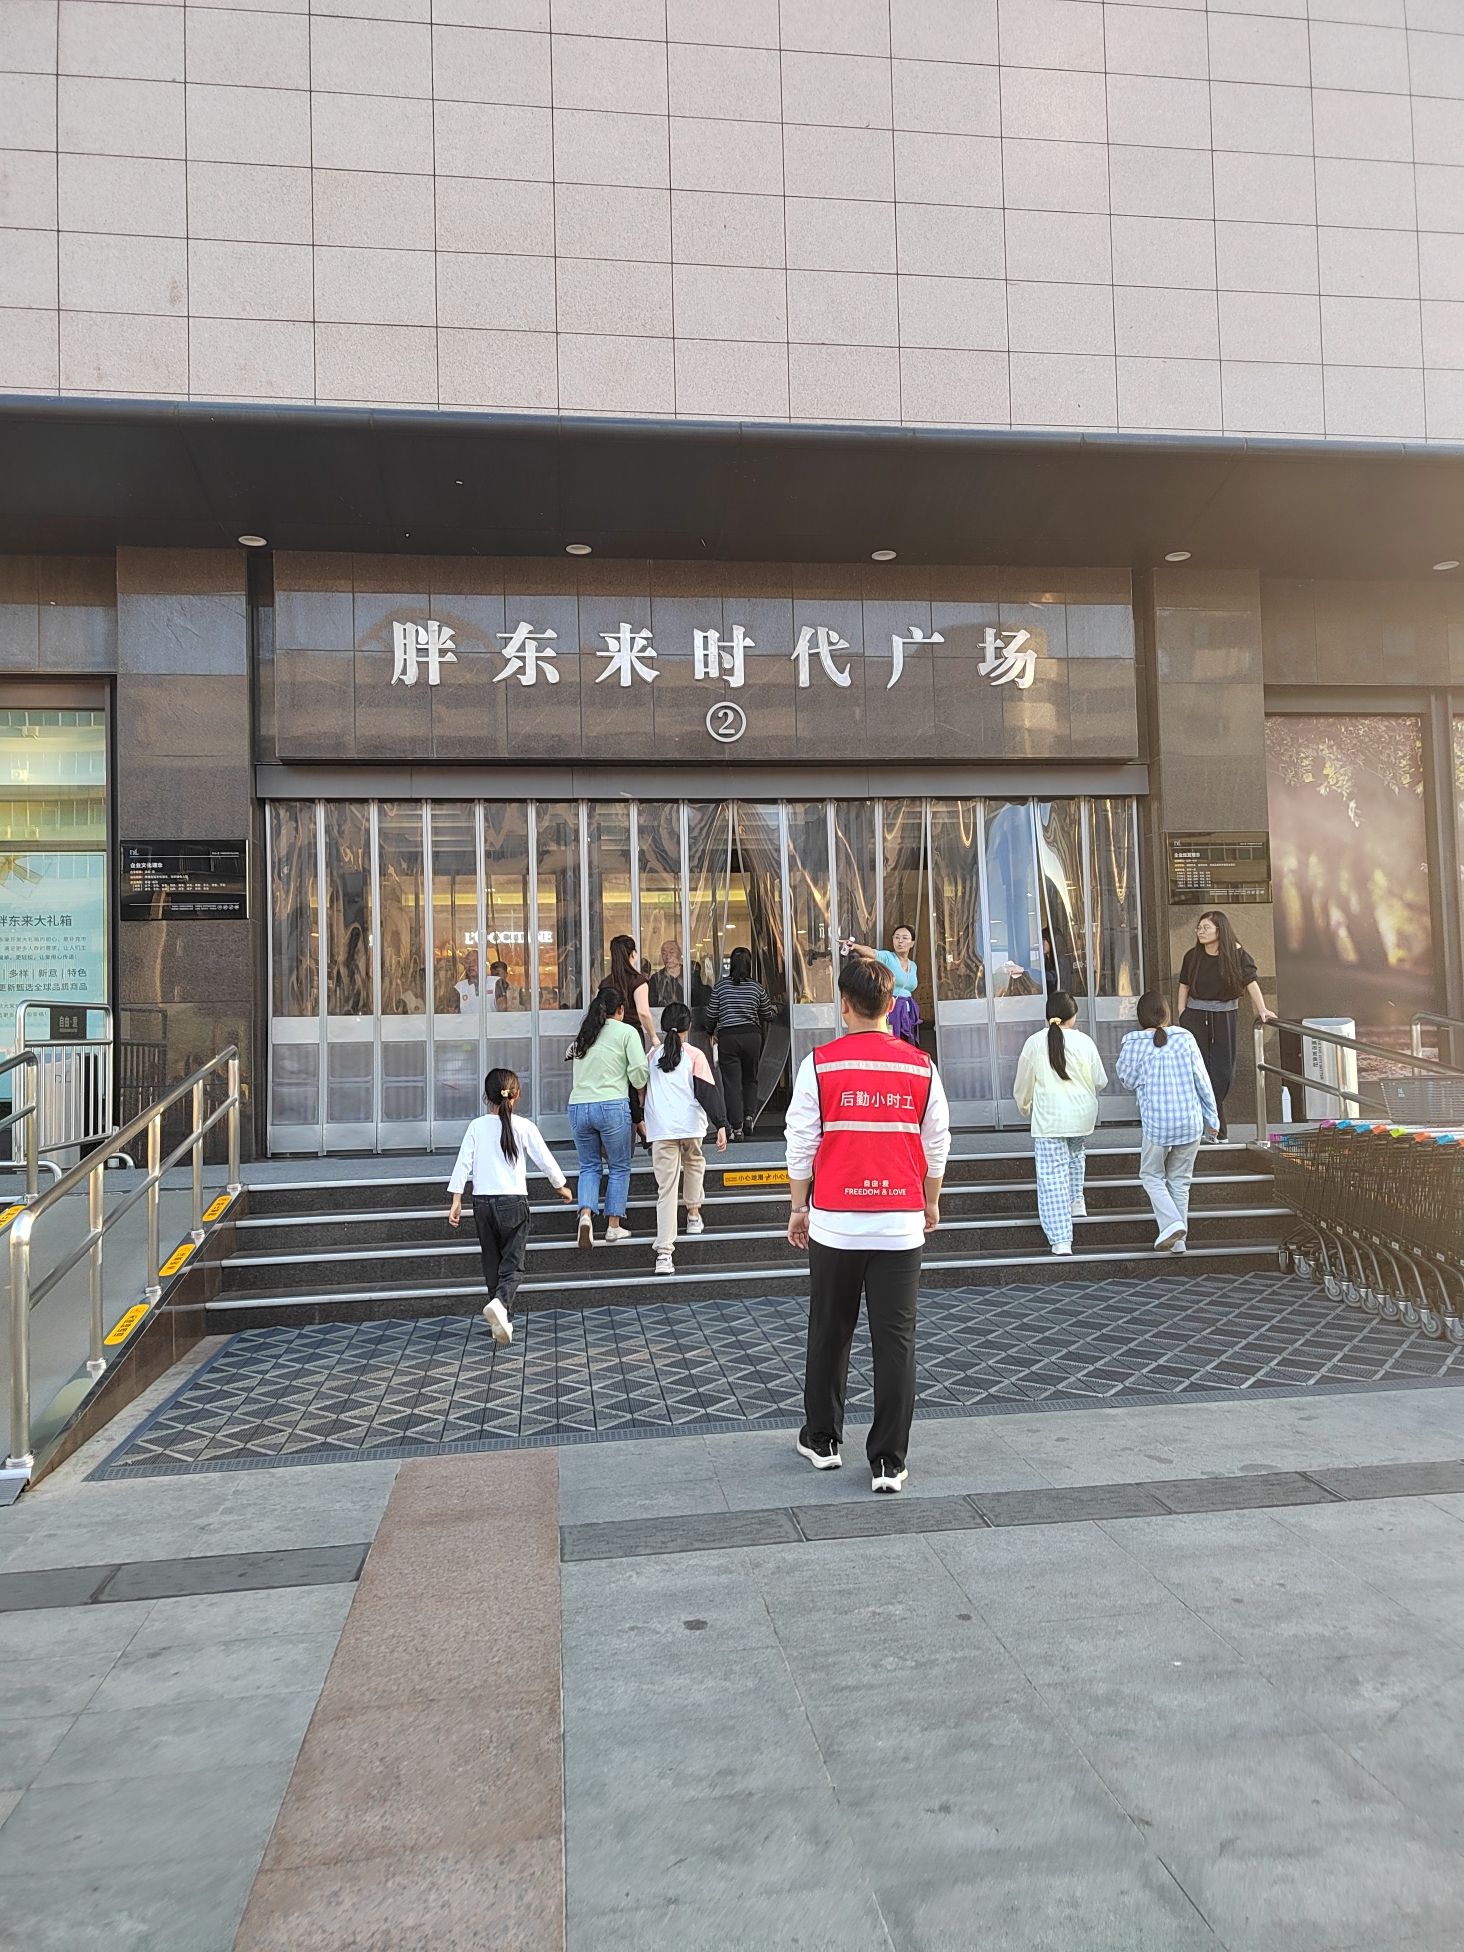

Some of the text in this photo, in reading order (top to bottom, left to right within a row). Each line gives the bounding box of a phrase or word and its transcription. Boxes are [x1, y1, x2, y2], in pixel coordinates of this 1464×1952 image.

[391, 621, 1037, 690] 胖东来时代广场
[840, 1090, 915, 1109] 后勤小时工
[844, 1187, 907, 1196] FREEDOM & LOVE
